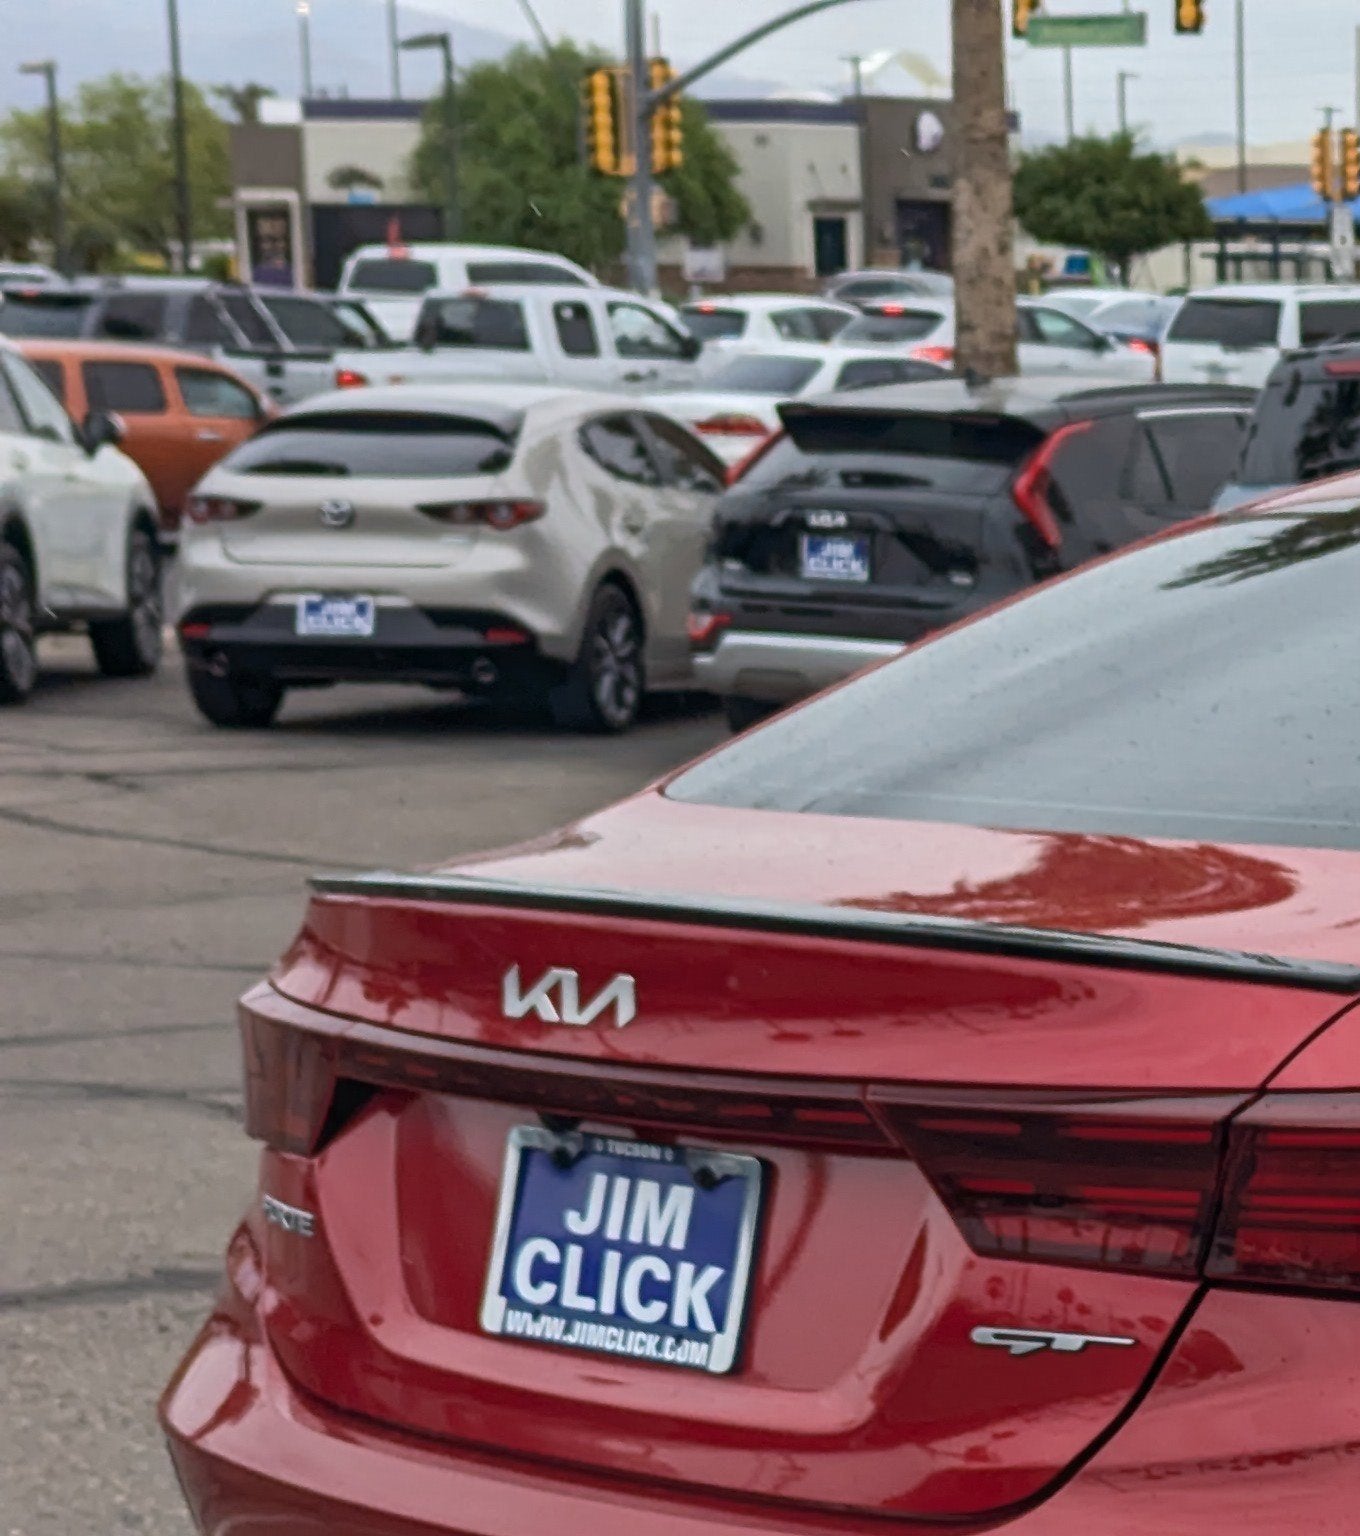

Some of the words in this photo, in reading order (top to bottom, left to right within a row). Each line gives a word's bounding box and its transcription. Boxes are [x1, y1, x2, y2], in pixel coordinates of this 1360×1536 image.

[503, 963, 636, 1028] KIA
[564, 1173, 694, 1250] JIM
[513, 1237, 725, 1332] CLICK
